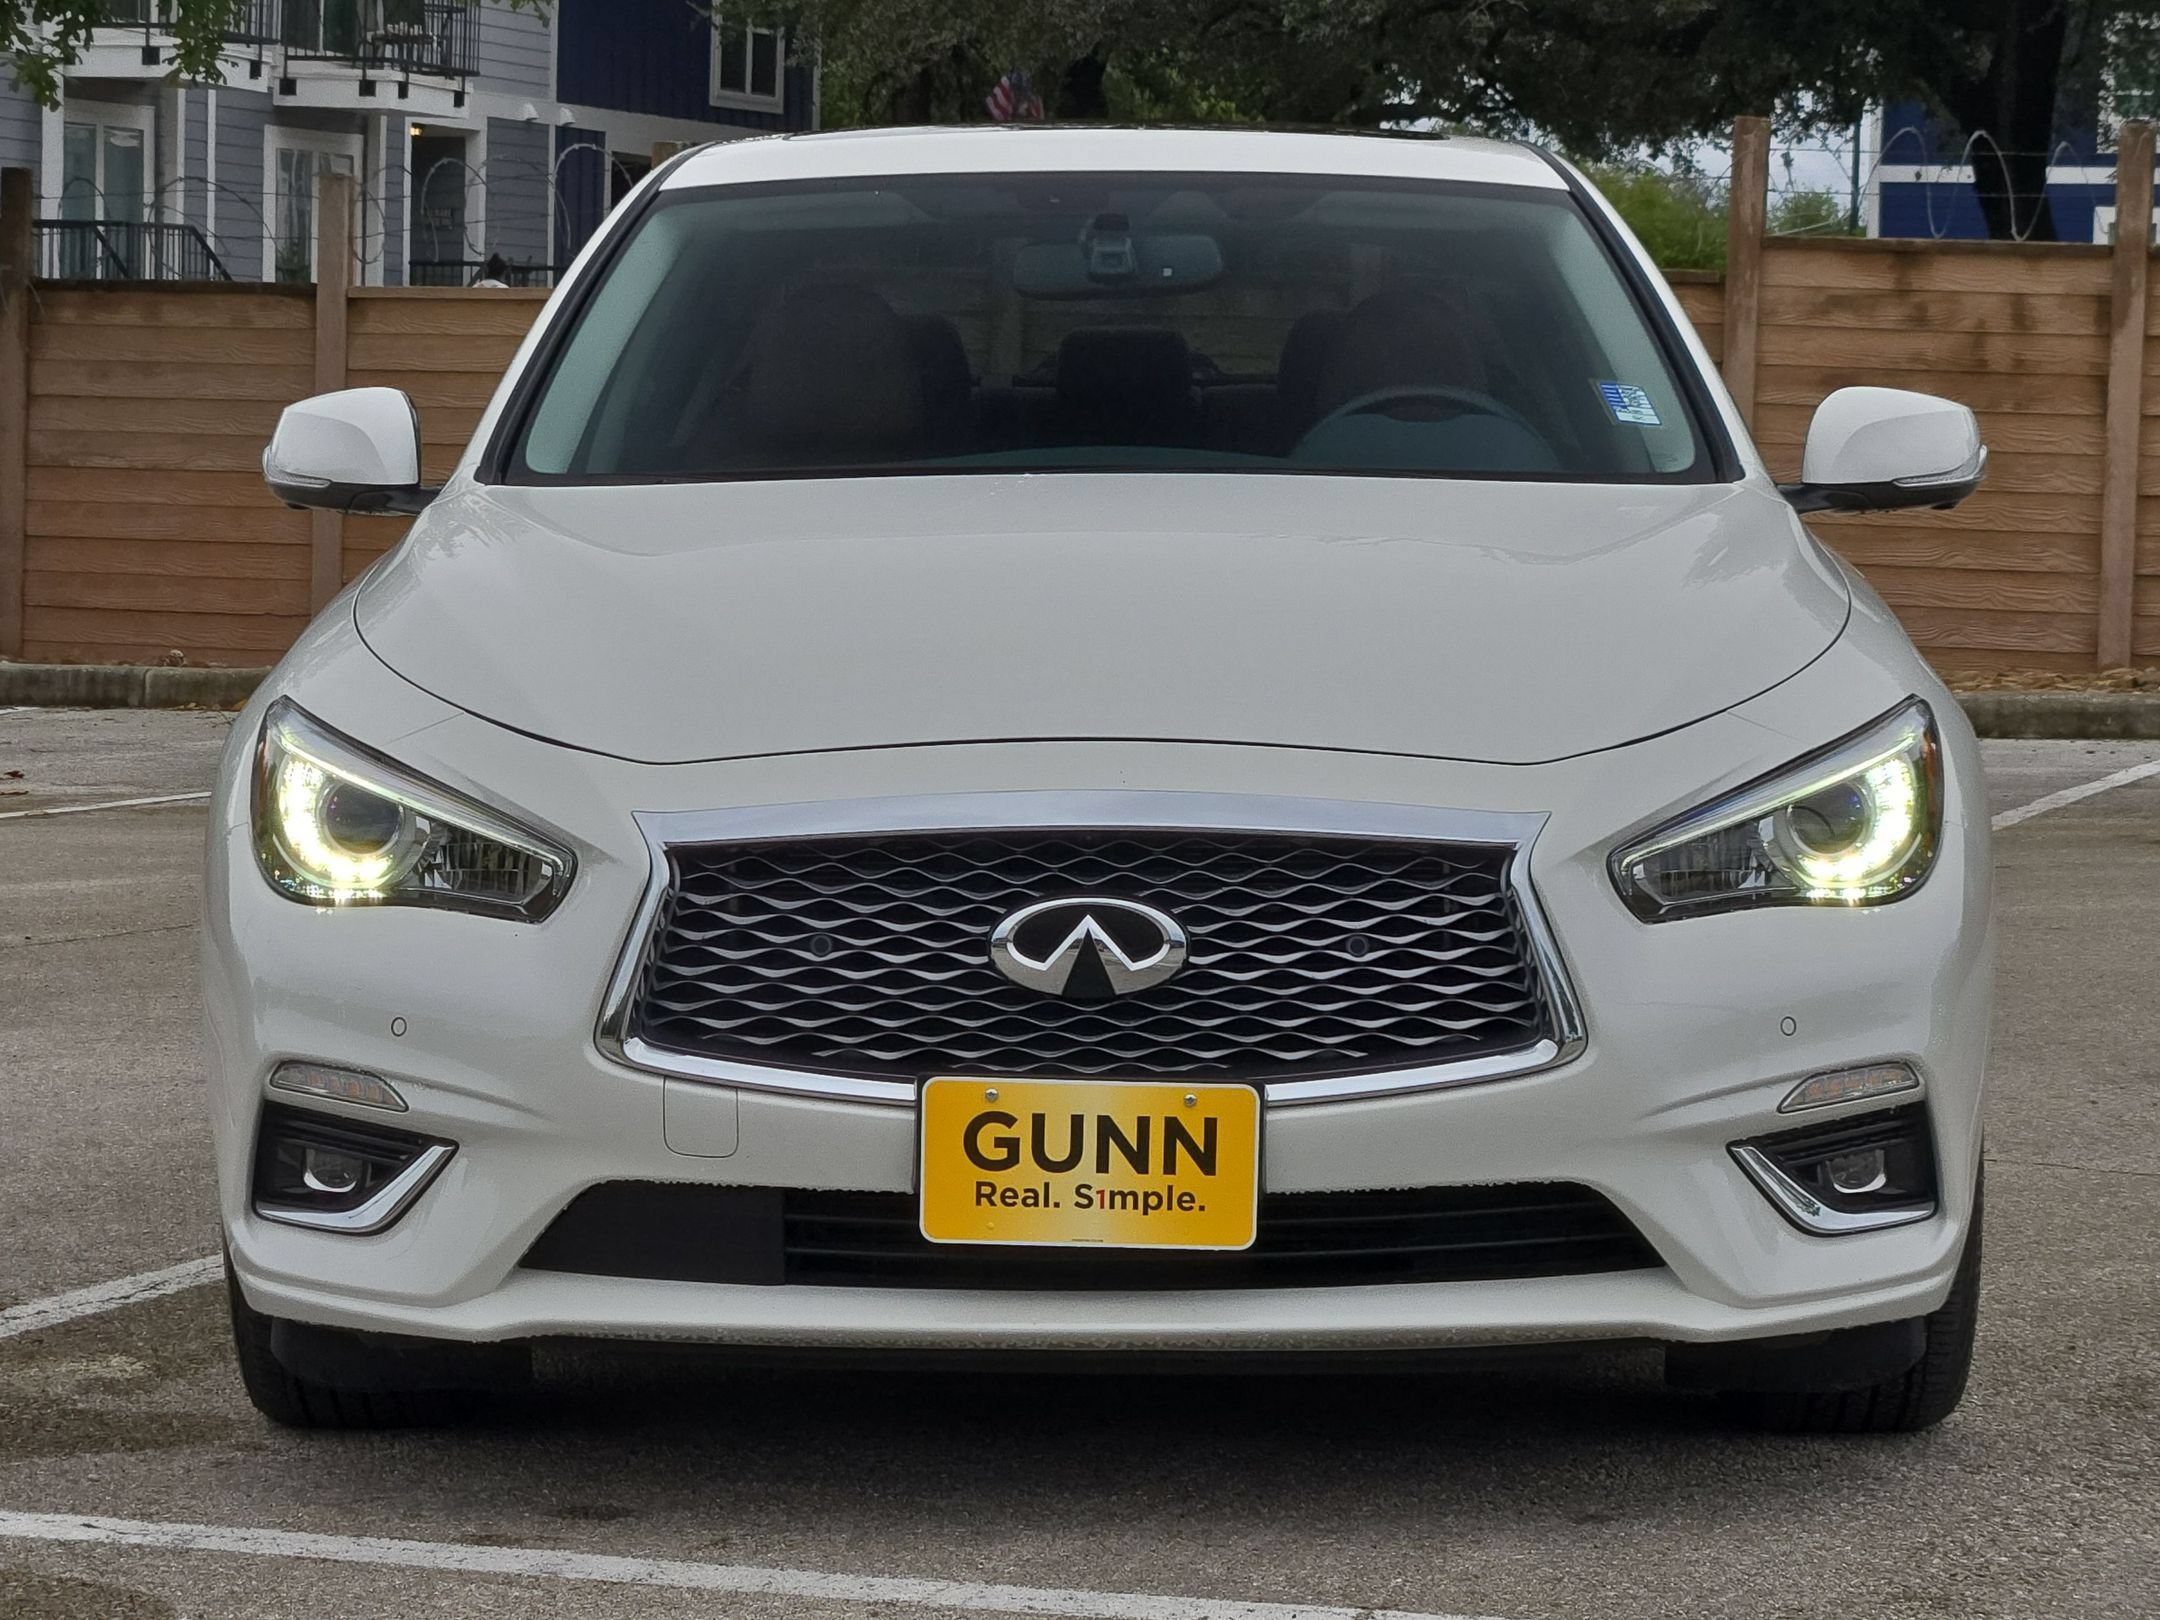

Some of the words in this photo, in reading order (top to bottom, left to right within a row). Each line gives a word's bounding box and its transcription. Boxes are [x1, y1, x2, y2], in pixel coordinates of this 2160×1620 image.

[963, 1110, 1218, 1176] GUNN
[975, 1181, 1061, 1209] Real.
[1073, 1183, 1206, 1216] S1mple.
